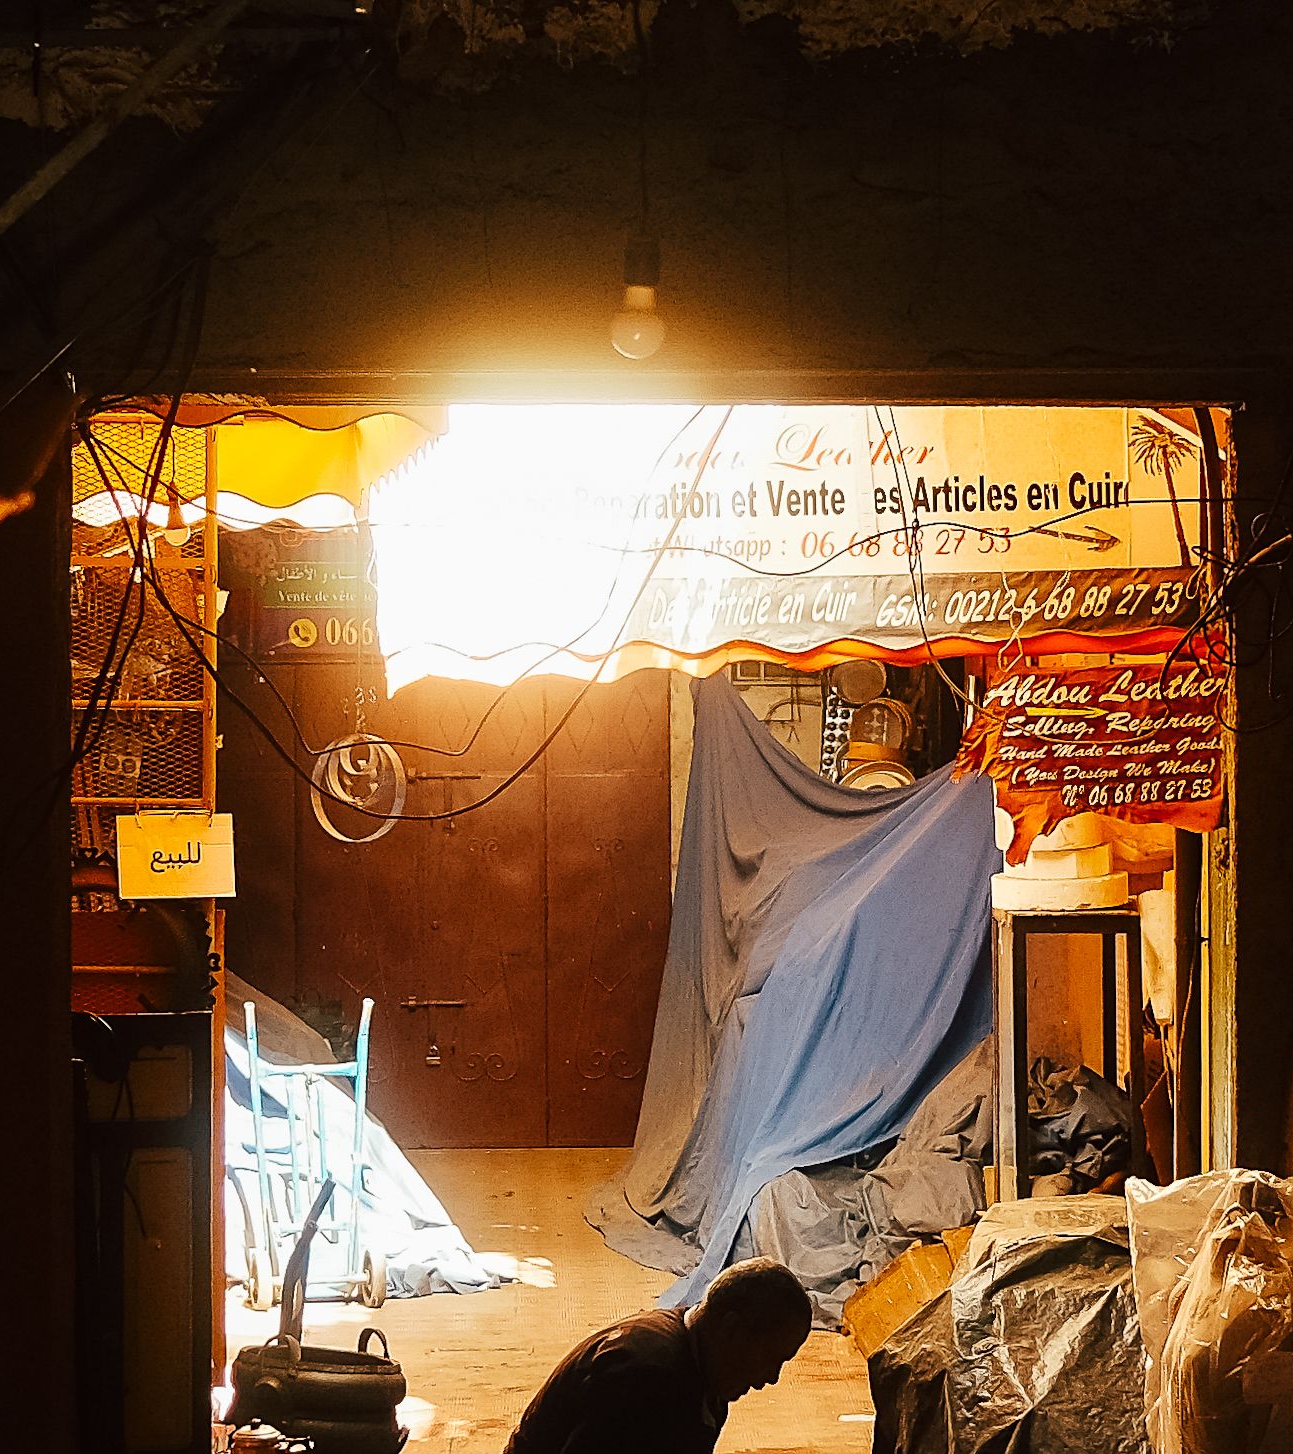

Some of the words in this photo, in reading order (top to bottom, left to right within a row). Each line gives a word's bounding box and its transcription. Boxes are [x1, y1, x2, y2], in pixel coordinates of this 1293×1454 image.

[770, 423, 934, 471] Leaher
[731, 482, 757, 517] et
[766, 480, 845, 517] Vente
[873, 487, 901, 514] es
[913, 475, 1018, 514] Articles
[1027, 481, 1059, 510] en
[800, 531, 835, 558] 06
[847, 531, 880, 557] 68
[935, 528, 965, 554] 27
[977, 527, 1012, 554] 53
[778, 594, 805, 624] en
[811, 581, 857, 622] Cuir
[876, 593, 939, 627] GSM:
[944, 586, 1017, 624] 00212
[1043, 586, 1076, 620] 68
[1079, 585, 1110, 618] 88
[1115, 584, 1150, 615] 27
[1152, 582, 1185, 613] 53
[983, 675, 1092, 707] Abdou
[1098, 668, 1227, 703] Leather
[999, 746, 1048, 760] Hand
[1051, 743, 1104, 758] Made
[1106, 740, 1171, 756] Leather
[1062, 765, 1118, 783] Design
[1123, 762, 1152, 777] We
[1088, 784, 1110, 806] 06
[1114, 782, 1135, 804] 68
[1140, 780, 1162, 803] 88
[1164, 779, 1187, 801] 27
[1190, 778, 1212, 799] 53
[150, 841, 202, 873] للبيع
